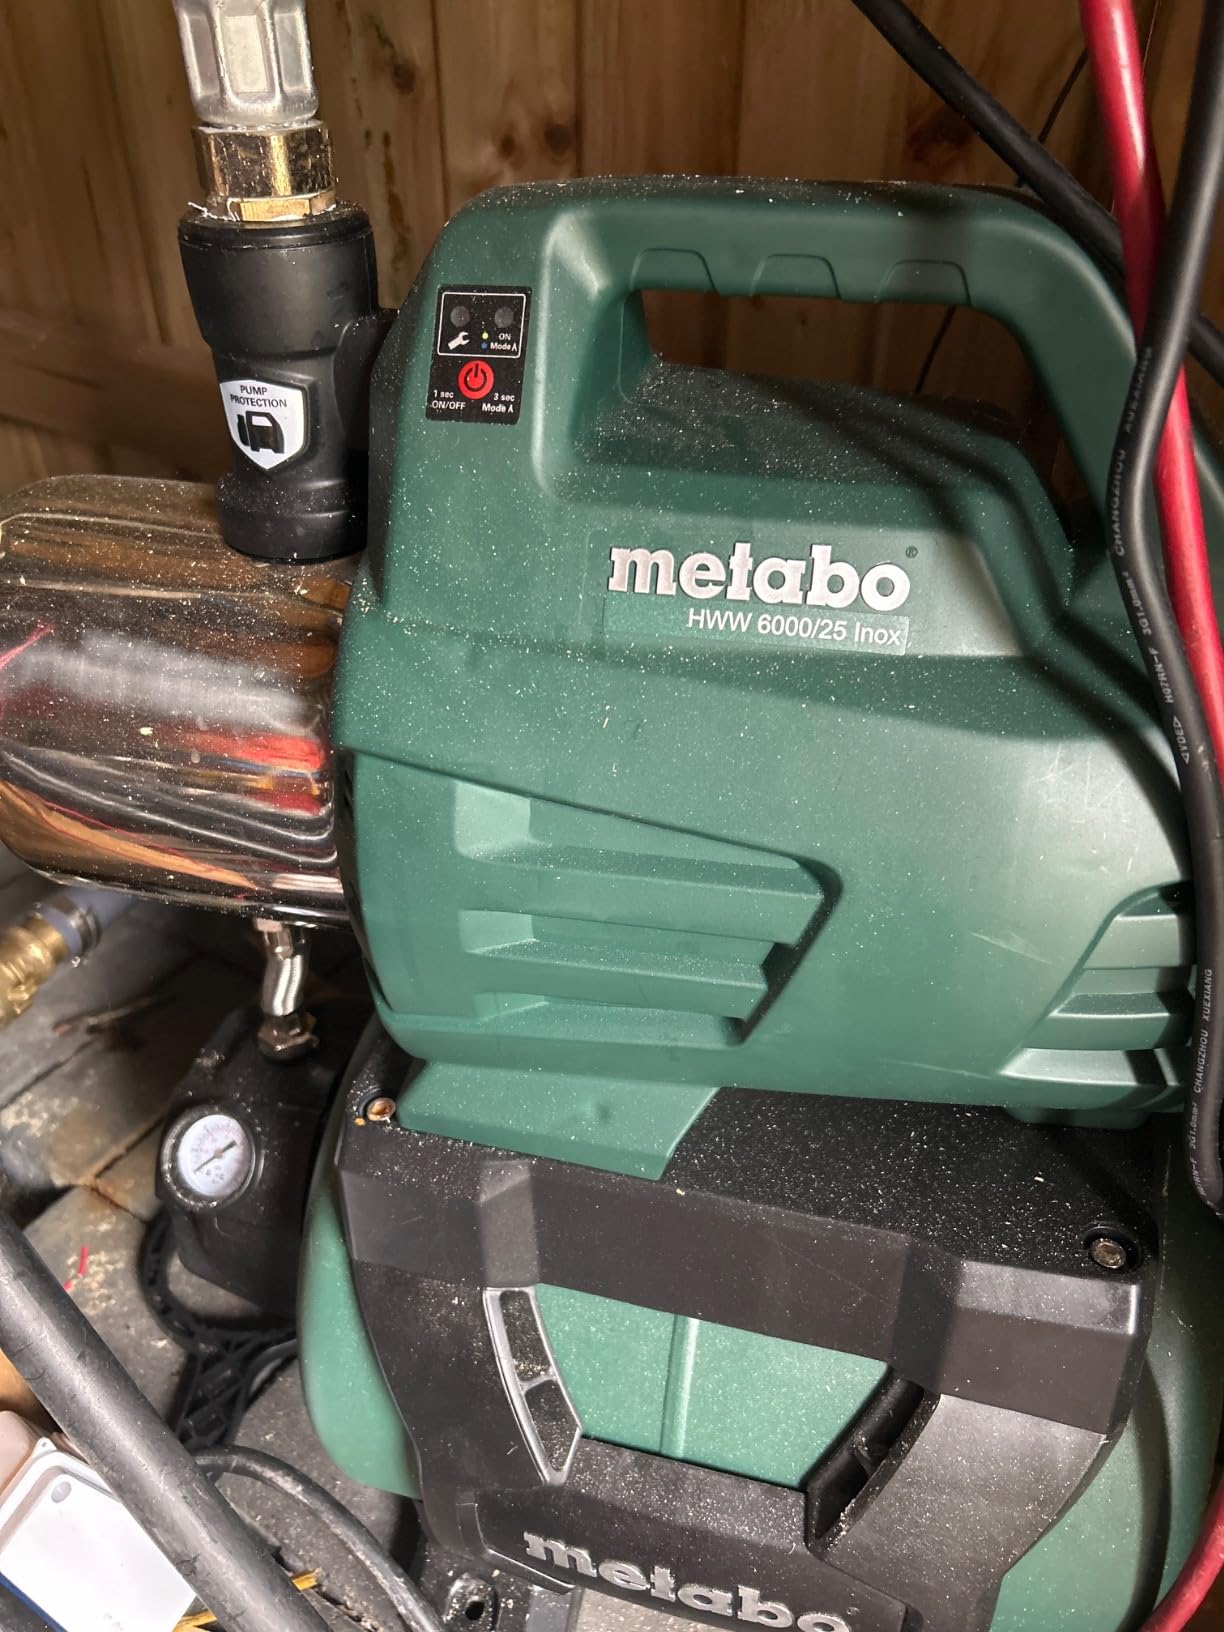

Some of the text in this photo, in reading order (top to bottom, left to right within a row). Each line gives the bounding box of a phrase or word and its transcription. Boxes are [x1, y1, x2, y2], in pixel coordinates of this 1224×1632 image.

[498, 332, 511, 341] ON
[490, 342, 511, 350] Mode
[240, 385, 268, 395] PUMP
[440, 391, 454, 399] sec
[230, 394, 287, 407] PROTECTION
[493, 392, 515, 402] 3 sec
[431, 401, 466, 410] ON/OFF
[482, 403, 506, 412] Mode
[607, 541, 911, 612] metabo
[687, 608, 903, 646] HWW 6000/25 Inox
[1193, 1029, 1209, 1094] CHANGZHOU
[1202, 969, 1213, 1022] XUEXIANG
[523, 1531, 850, 1632] metabo
